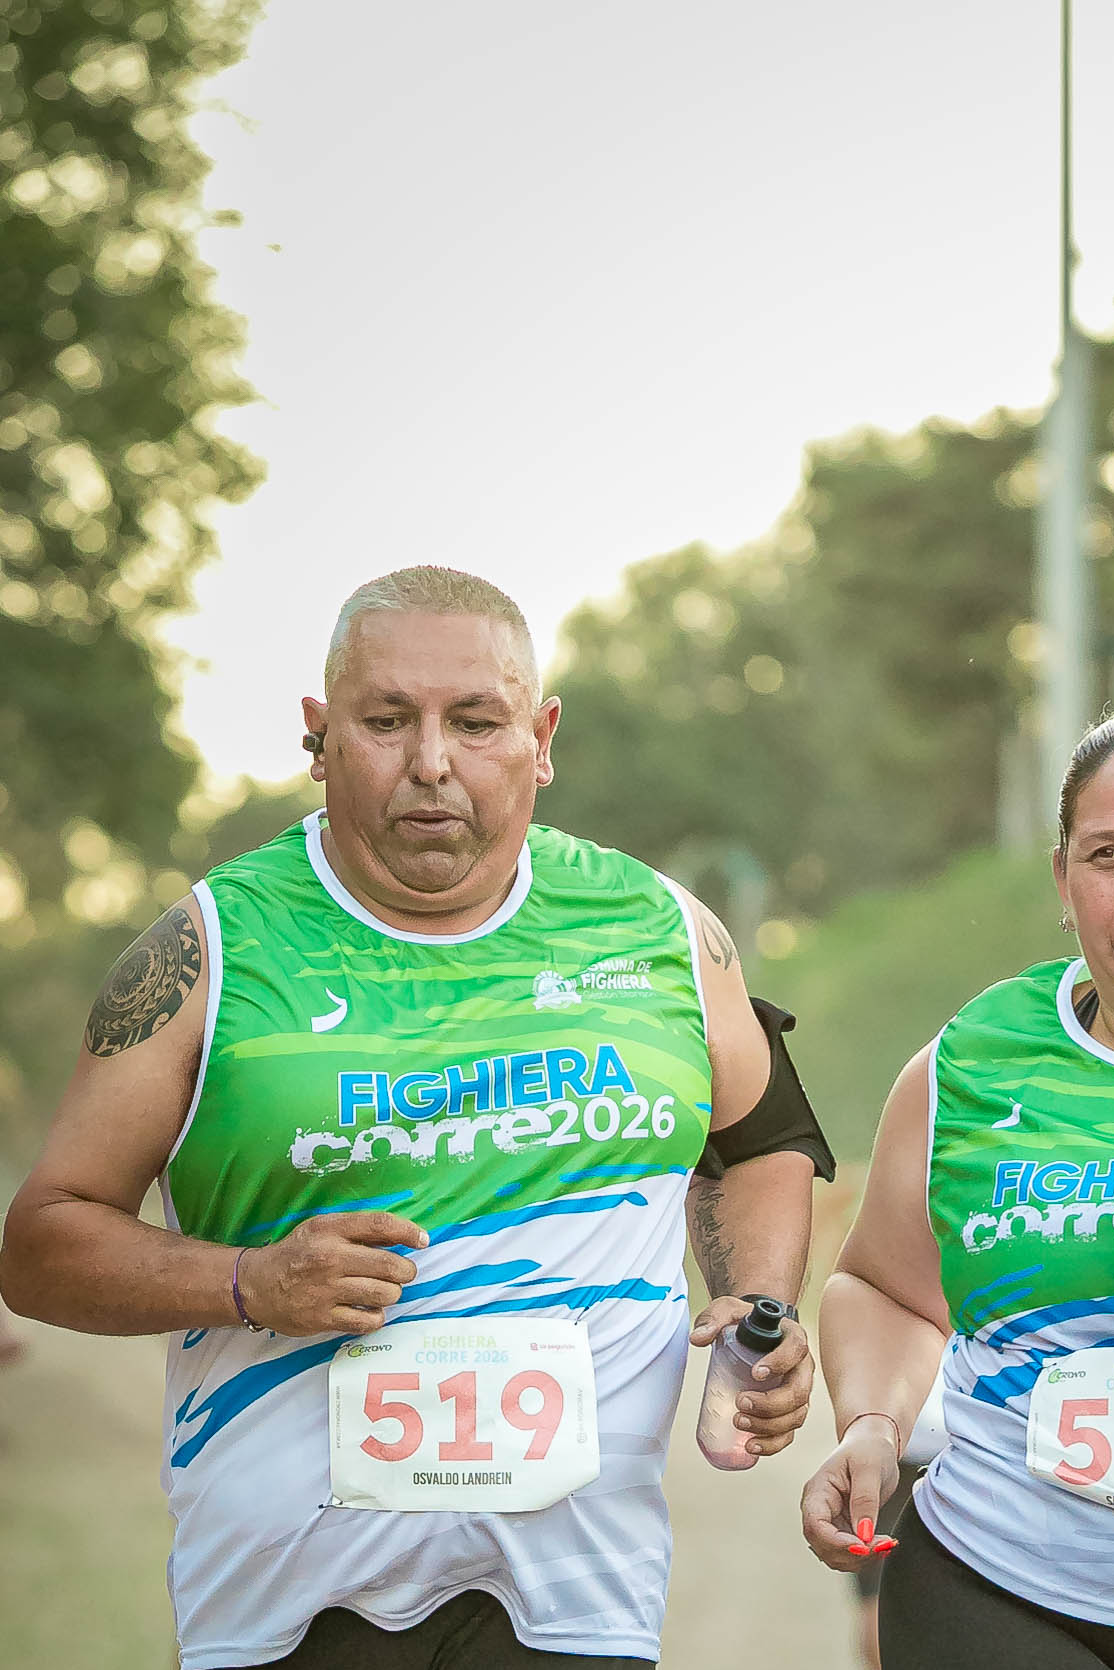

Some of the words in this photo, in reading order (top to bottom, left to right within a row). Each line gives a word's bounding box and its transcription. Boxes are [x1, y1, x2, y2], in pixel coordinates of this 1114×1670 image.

[637, 961, 653, 973] DE
[581, 972, 652, 990] FIGHIERA
[338, 1043, 637, 1127] FIGHIERA
[422, 1335, 497, 1349] FIGHIERA
[415, 1351, 468, 1364] CORRE
[474, 1351, 509, 1364] 2026
[360, 1369, 564, 1462] 519
[413, 1472, 460, 1486] OSVALDO
[462, 1471, 512, 1486] LANDREIN
